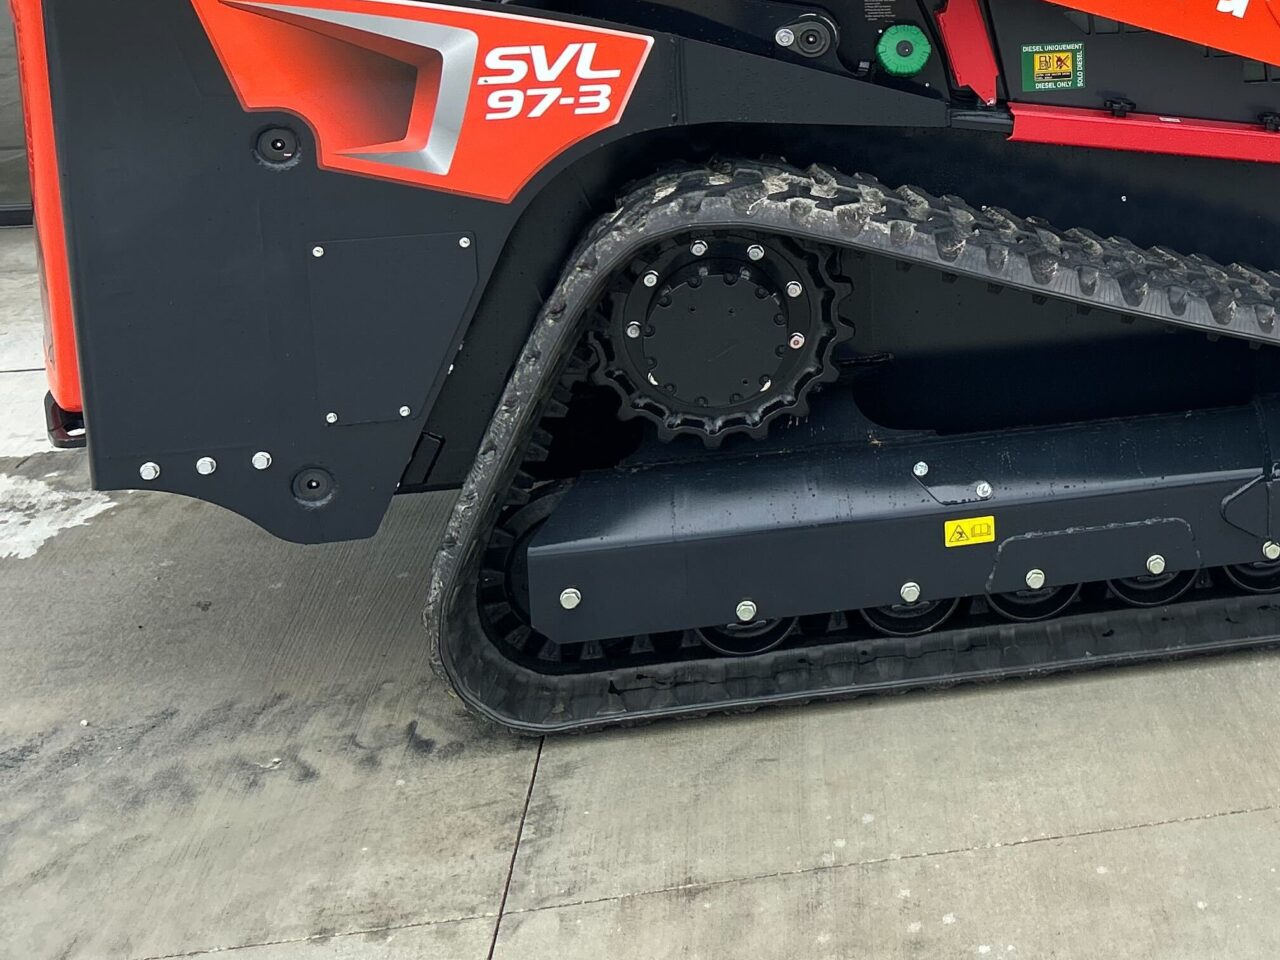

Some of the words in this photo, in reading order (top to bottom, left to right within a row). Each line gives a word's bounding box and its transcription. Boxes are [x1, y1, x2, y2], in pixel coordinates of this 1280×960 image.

[477, 42, 621, 85] SVL
[1044, 43, 1082, 51] UNIQUEMENT
[485, 84, 611, 120] 97-3
